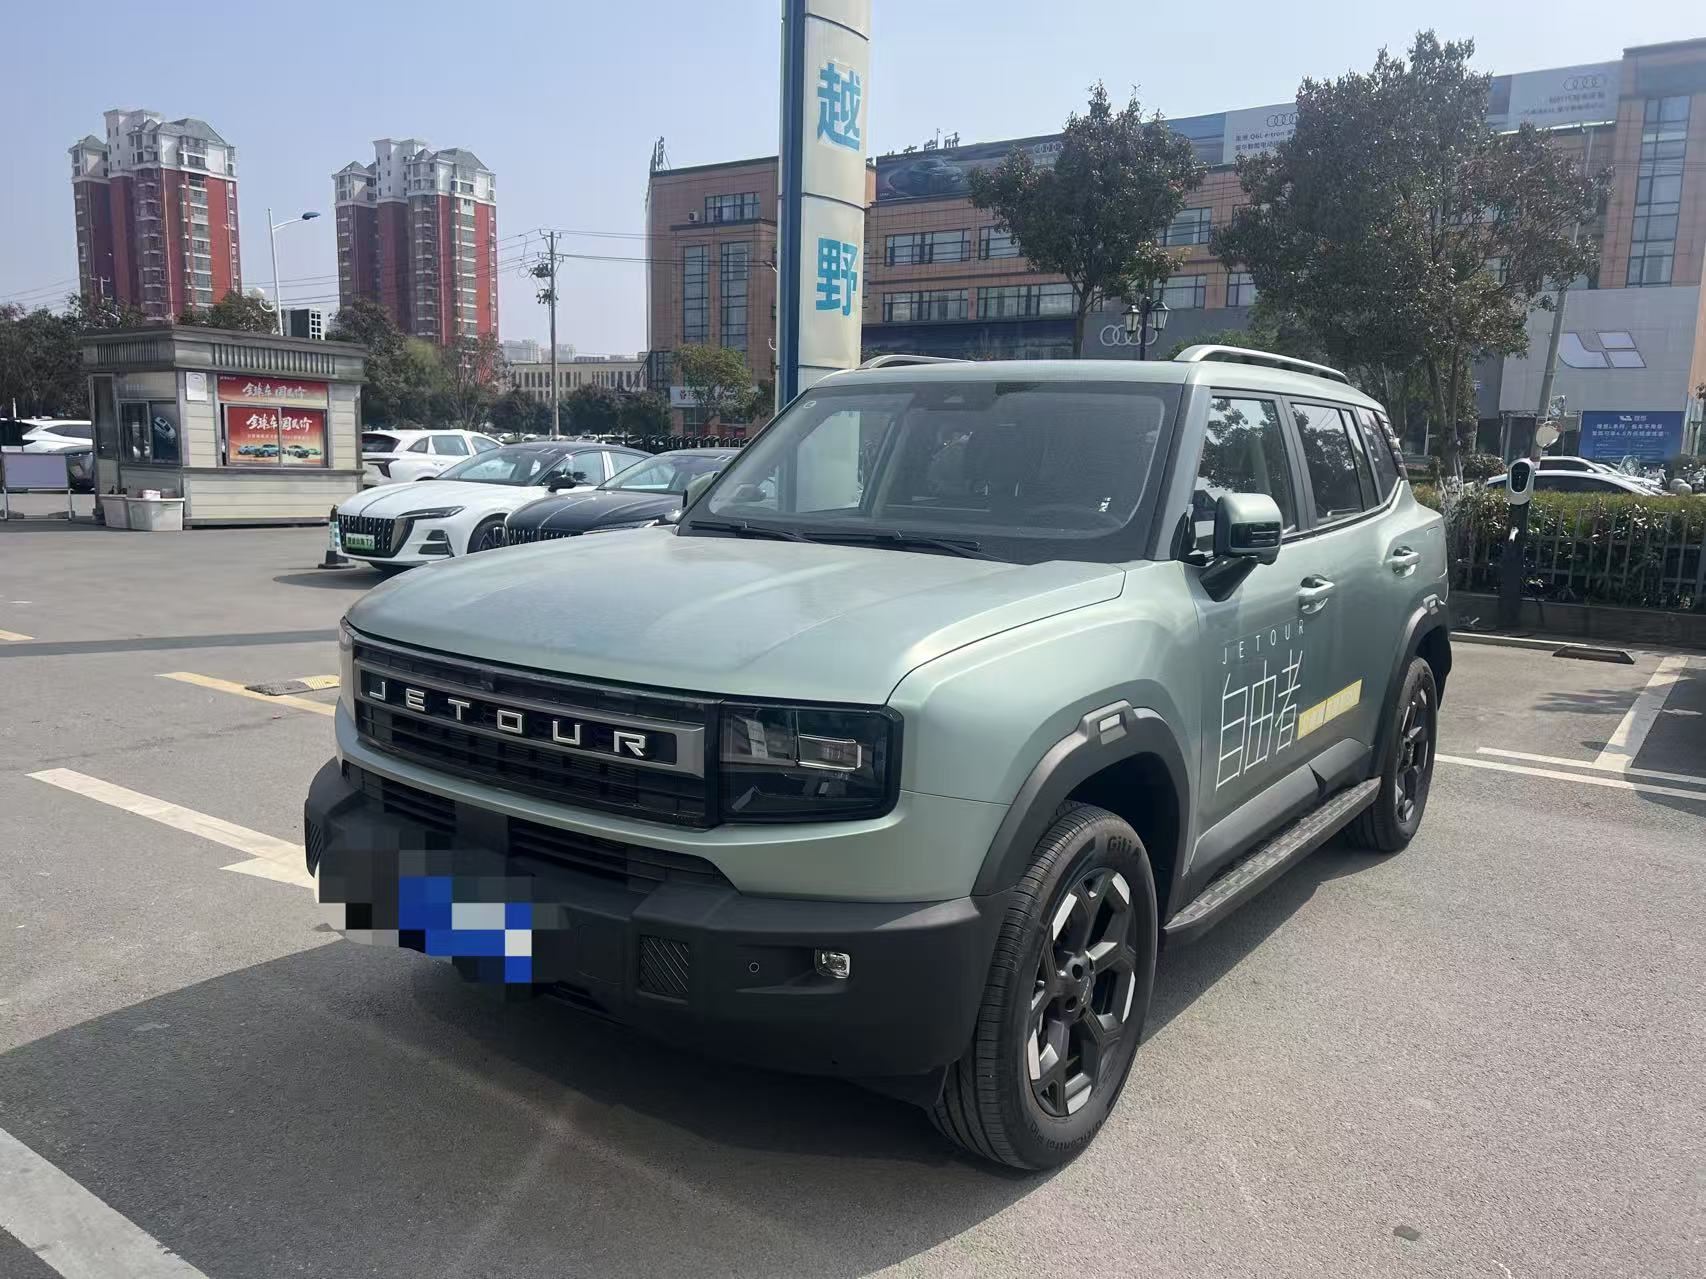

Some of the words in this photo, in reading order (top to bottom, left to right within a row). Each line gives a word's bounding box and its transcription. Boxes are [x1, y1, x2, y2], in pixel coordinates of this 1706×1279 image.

[816, 62, 861, 317] 越野
[1222, 619, 1304, 665] JETOUR
[368, 680, 647, 757] JETOUR
[1215, 649, 1304, 792] 自由者
